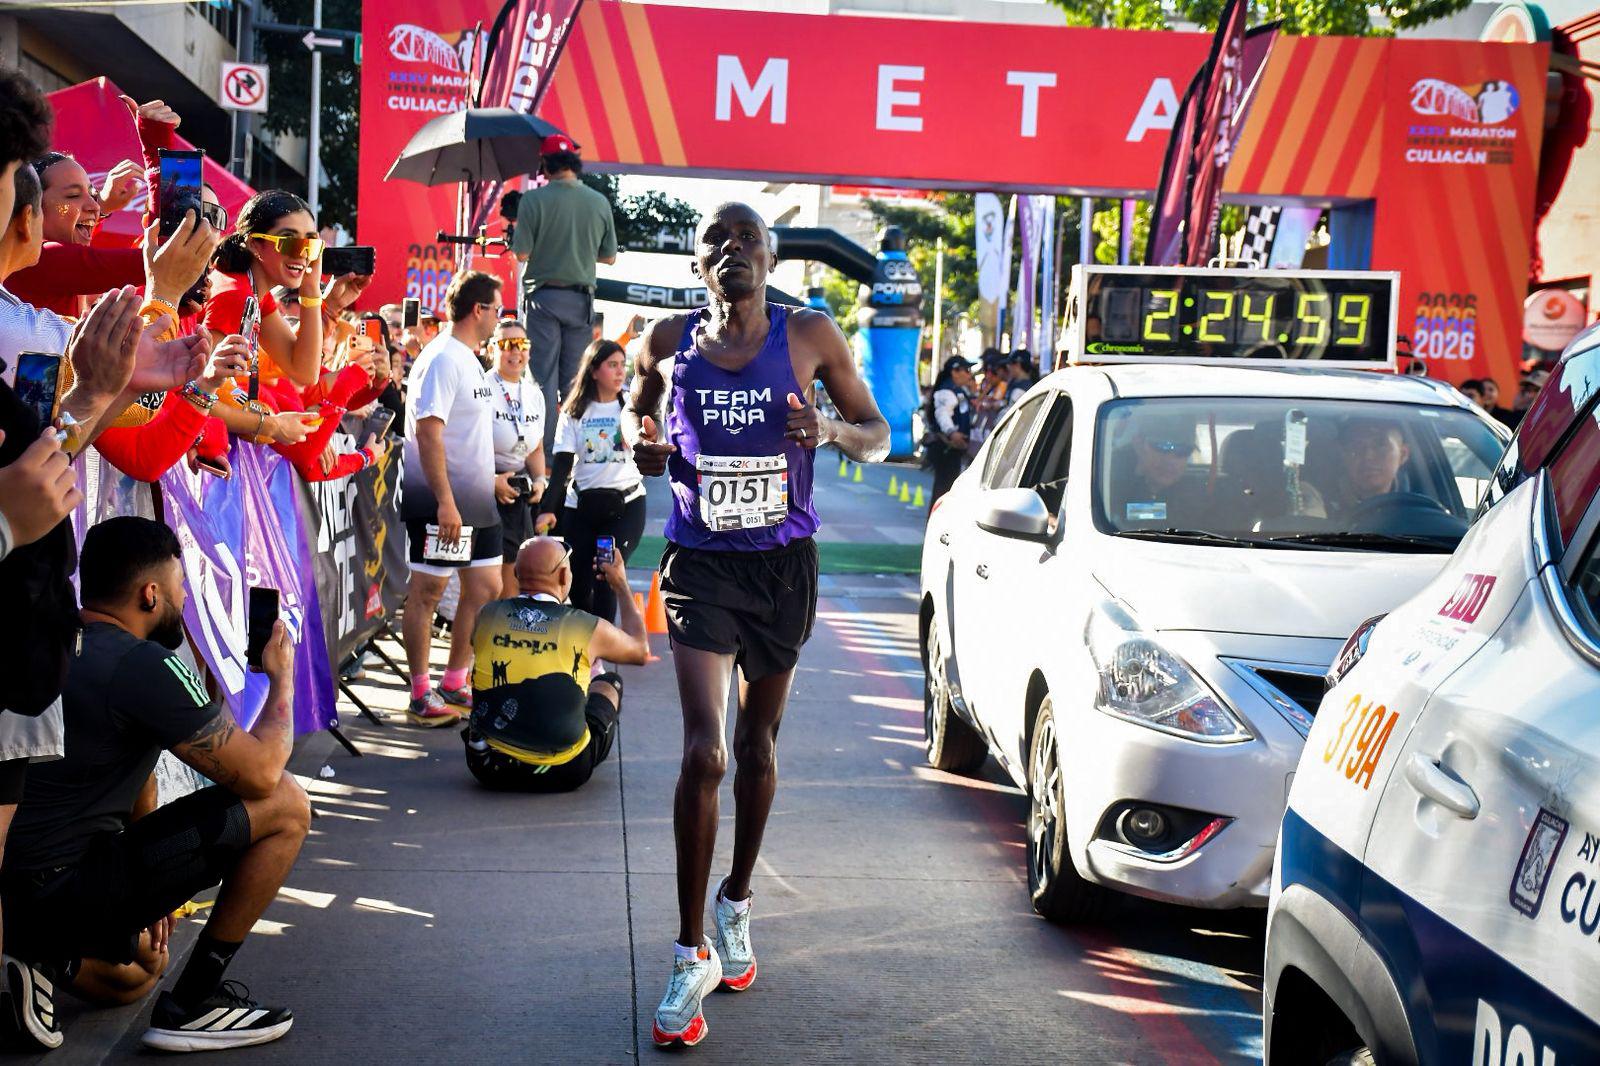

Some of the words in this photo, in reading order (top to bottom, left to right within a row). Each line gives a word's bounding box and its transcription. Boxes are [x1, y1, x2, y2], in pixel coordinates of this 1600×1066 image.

[432, 75, 469, 87] MARA
[715, 55, 1181, 142] META
[1450, 127, 1517, 138] MARATÓN
[1405, 147, 1488, 164] CULIACÁN
[407, 282, 449, 313] 202
[626, 284, 710, 307] SALID
[1143, 290, 1371, 345] 2:24.59
[1413, 330, 1476, 360] 2026
[695, 387, 772, 406] TEAM
[702, 406, 765, 426] PIÑA
[729, 460, 750, 469] 42K
[708, 477, 770, 507] 0151
[745, 516, 761, 525] 0151
[1323, 693, 1400, 791] 319A
[1560, 871, 1600, 936] CU
